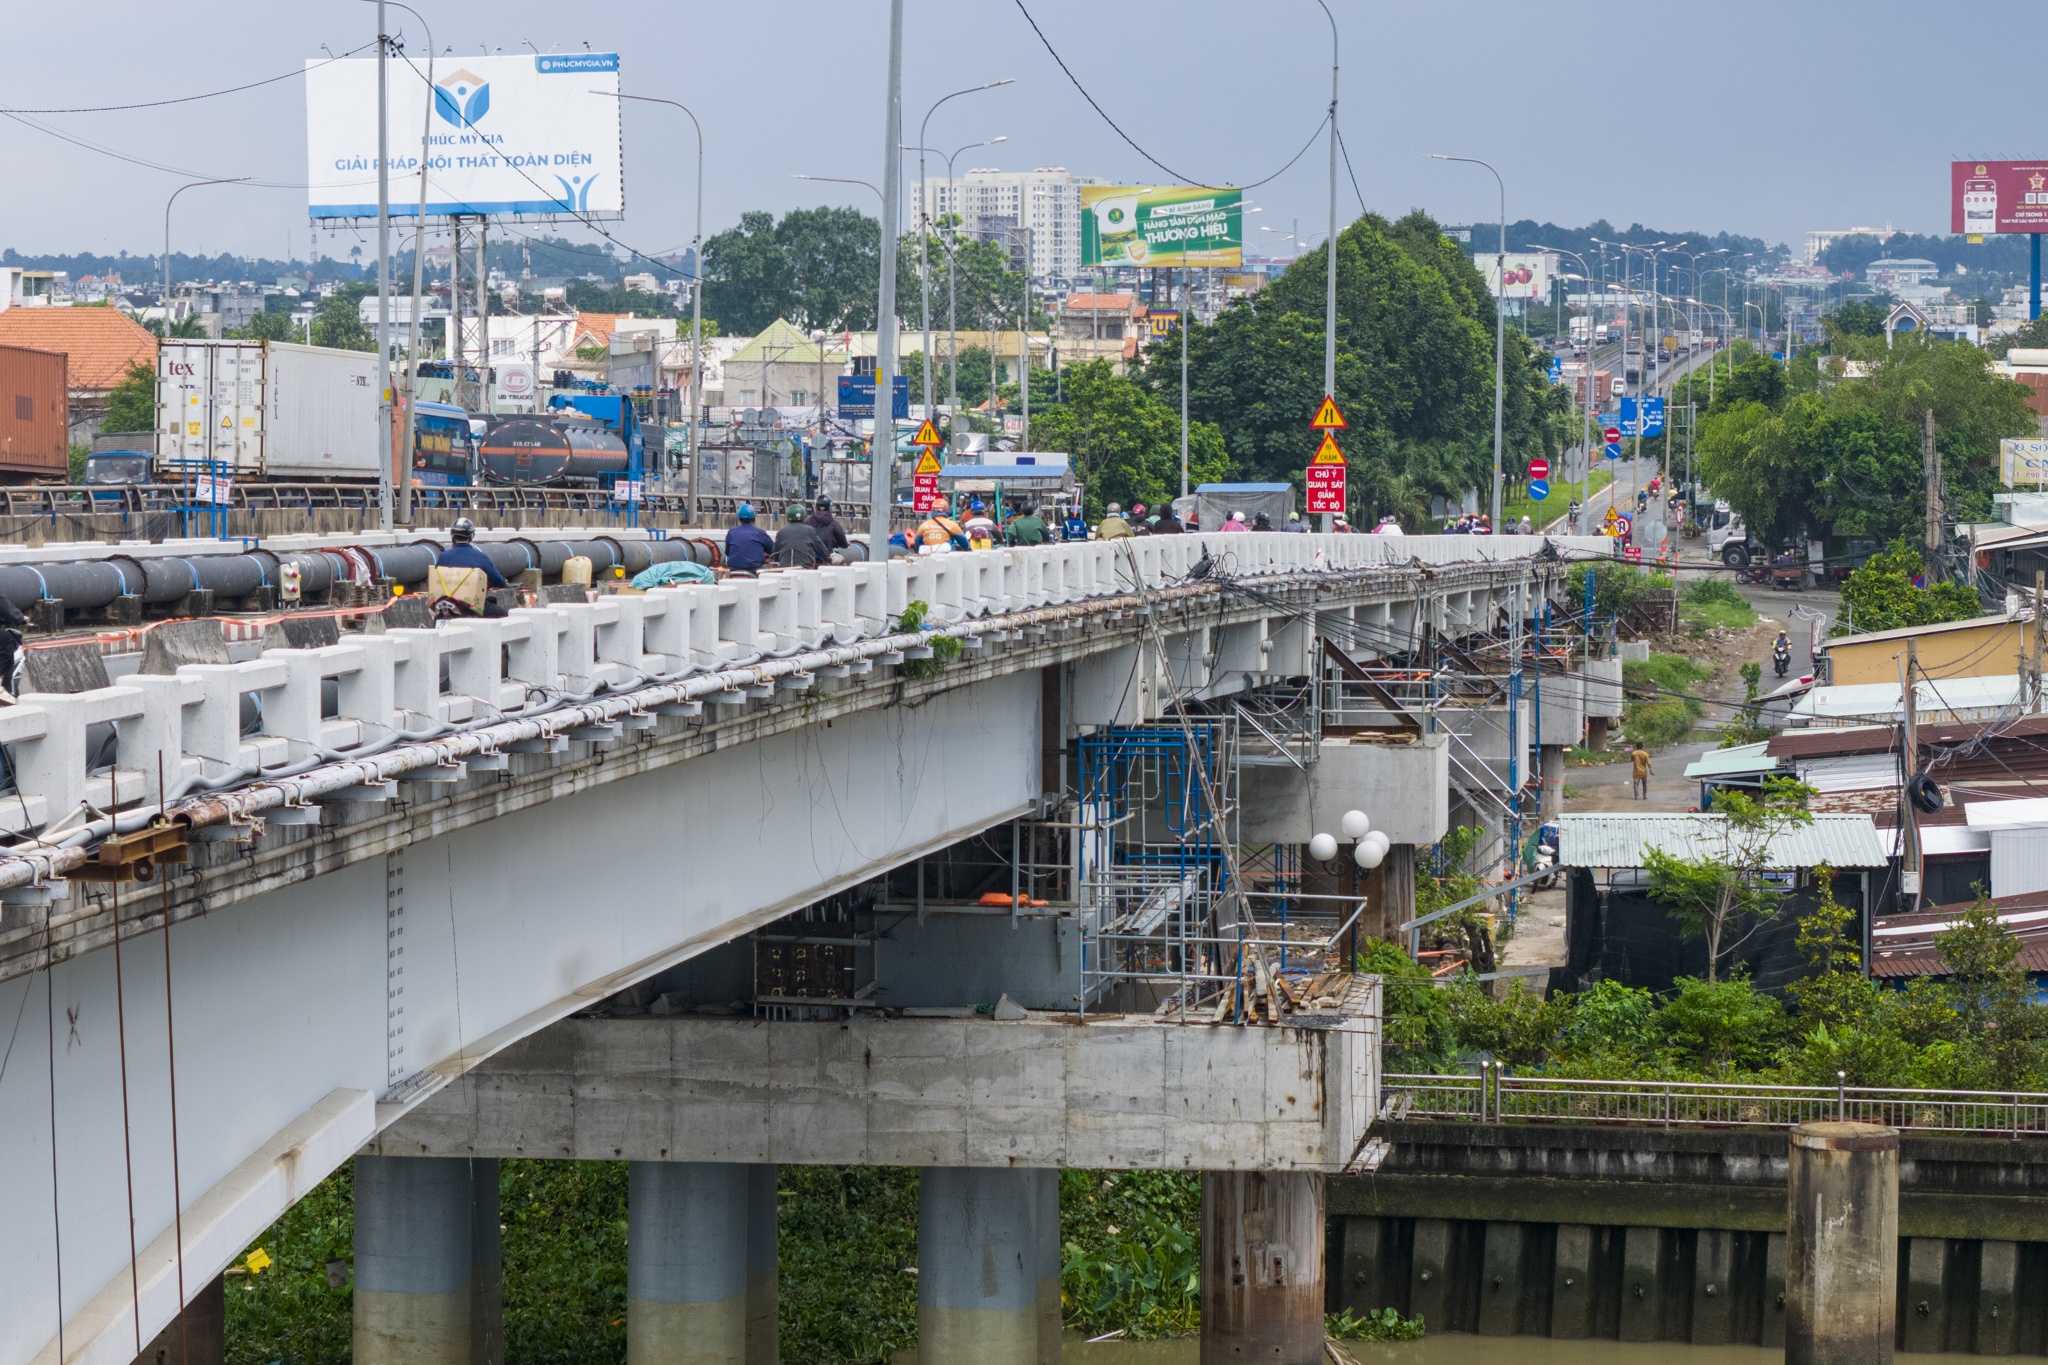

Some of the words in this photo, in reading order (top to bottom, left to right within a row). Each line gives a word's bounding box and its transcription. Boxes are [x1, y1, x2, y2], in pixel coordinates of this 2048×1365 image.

[552, 60, 613, 68] PHUCMYGIA.VN
[459, 132, 479, 144] MỸ
[482, 134, 504, 144] GIA
[335, 154, 368, 170] GIẢI
[456, 152, 499, 168] THẤT
[504, 152, 549, 167] TOÀN
[554, 150, 592, 168] DIỆN
[1145, 226, 1198, 244] THƯƠNG
[1200, 222, 1228, 240] HIỆU
[168, 360, 195, 376] tex
[356, 376, 366, 386] NYK
[1315, 470, 1330, 478] CHÚ
[1332, 470, 1336, 478] Ý
[1331, 480, 1344, 488] SÁT
[1318, 489, 1335, 498] GIẢM
[918, 500, 929, 509] TỐC
[1312, 499, 1326, 509] TỐC
[1330, 500, 1340, 510] ĐỘ
